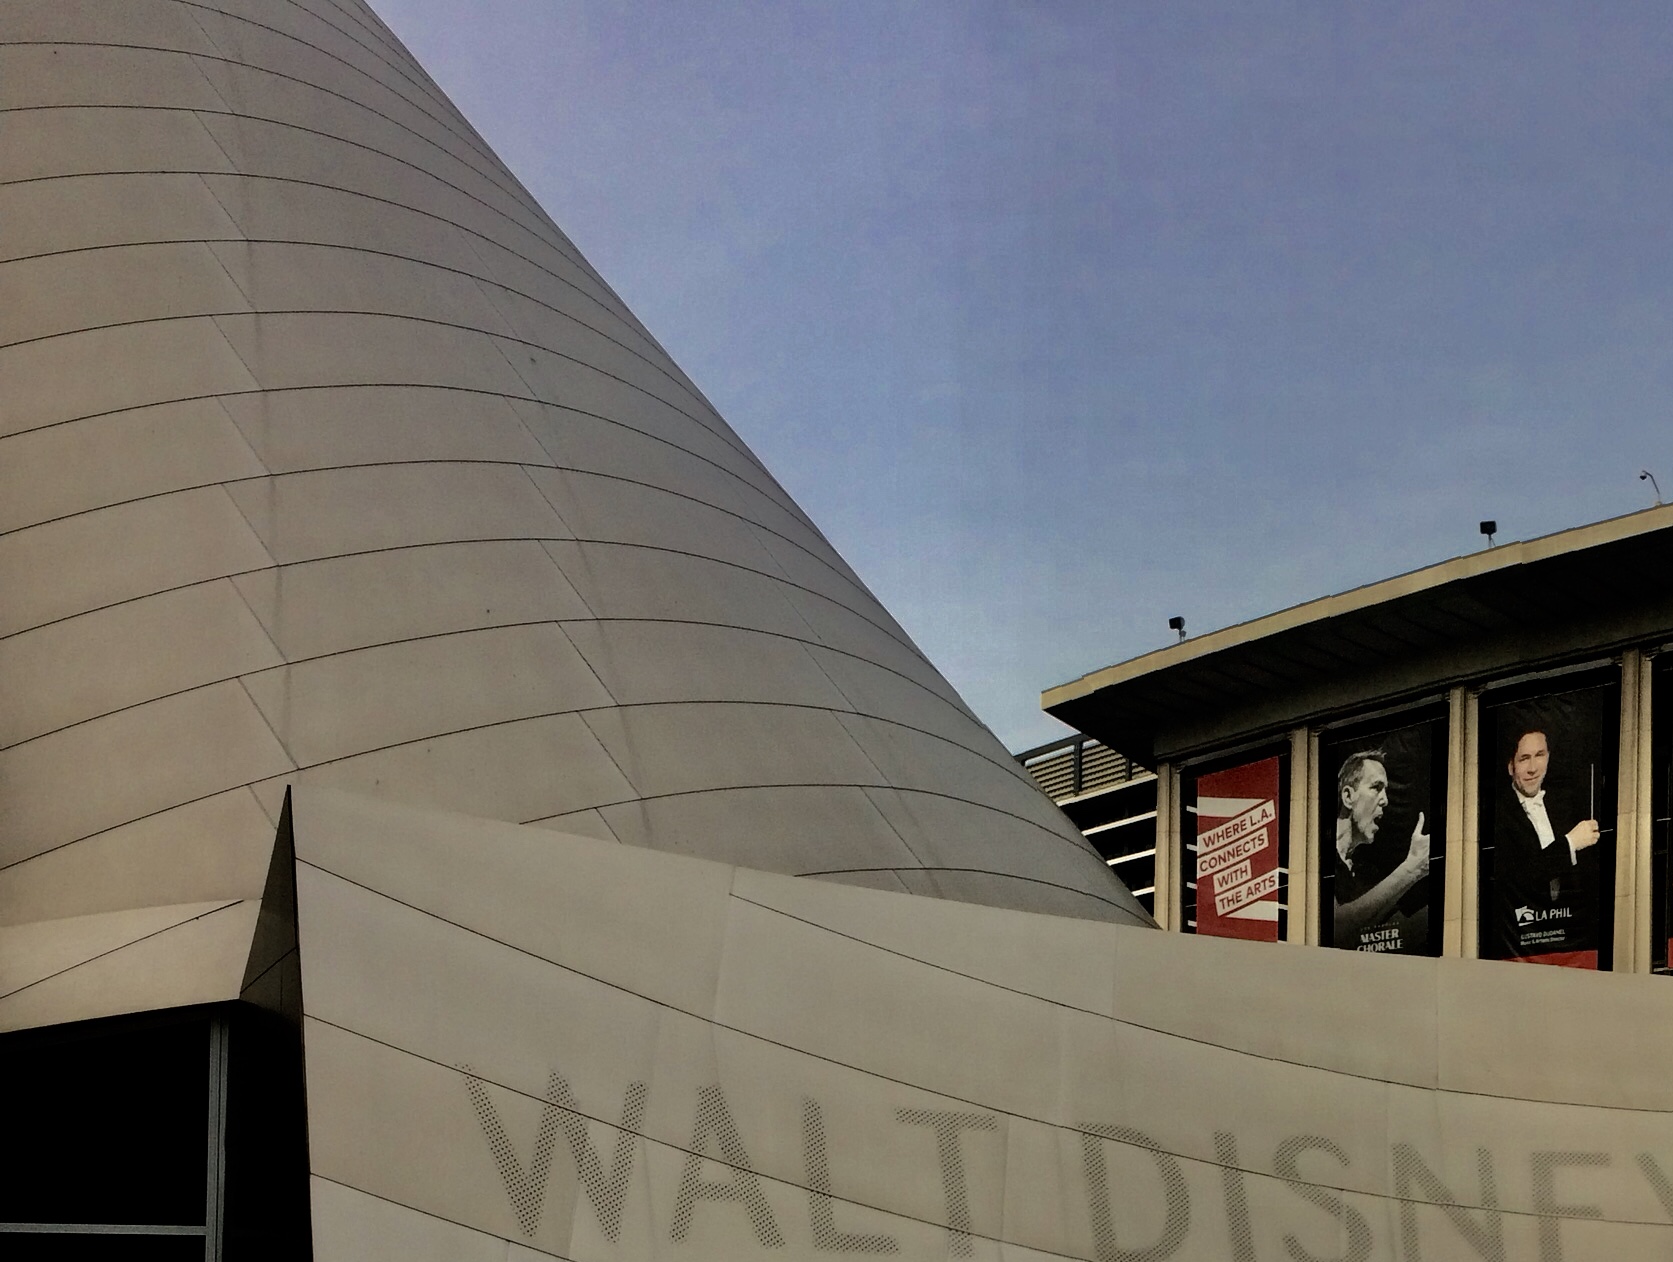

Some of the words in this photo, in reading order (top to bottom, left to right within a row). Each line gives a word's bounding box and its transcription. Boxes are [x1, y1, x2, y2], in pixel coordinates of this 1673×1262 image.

[1203, 819, 1247, 848] WHERE
[1250, 808, 1273, 827] L.A.
[1200, 833, 1265, 872] CONNECTS
[1217, 865, 1248, 888] WITH
[1219, 891, 1243, 910] THE
[1245, 875, 1276, 898] ARTS
[1535, 910, 1548, 921] LA
[1549, 907, 1572, 919] PHIL
[1357, 938, 1403, 953] CHORALE
[1360, 928, 1399, 943] MASTER
[454, 1062, 1000, 1262] WALT
